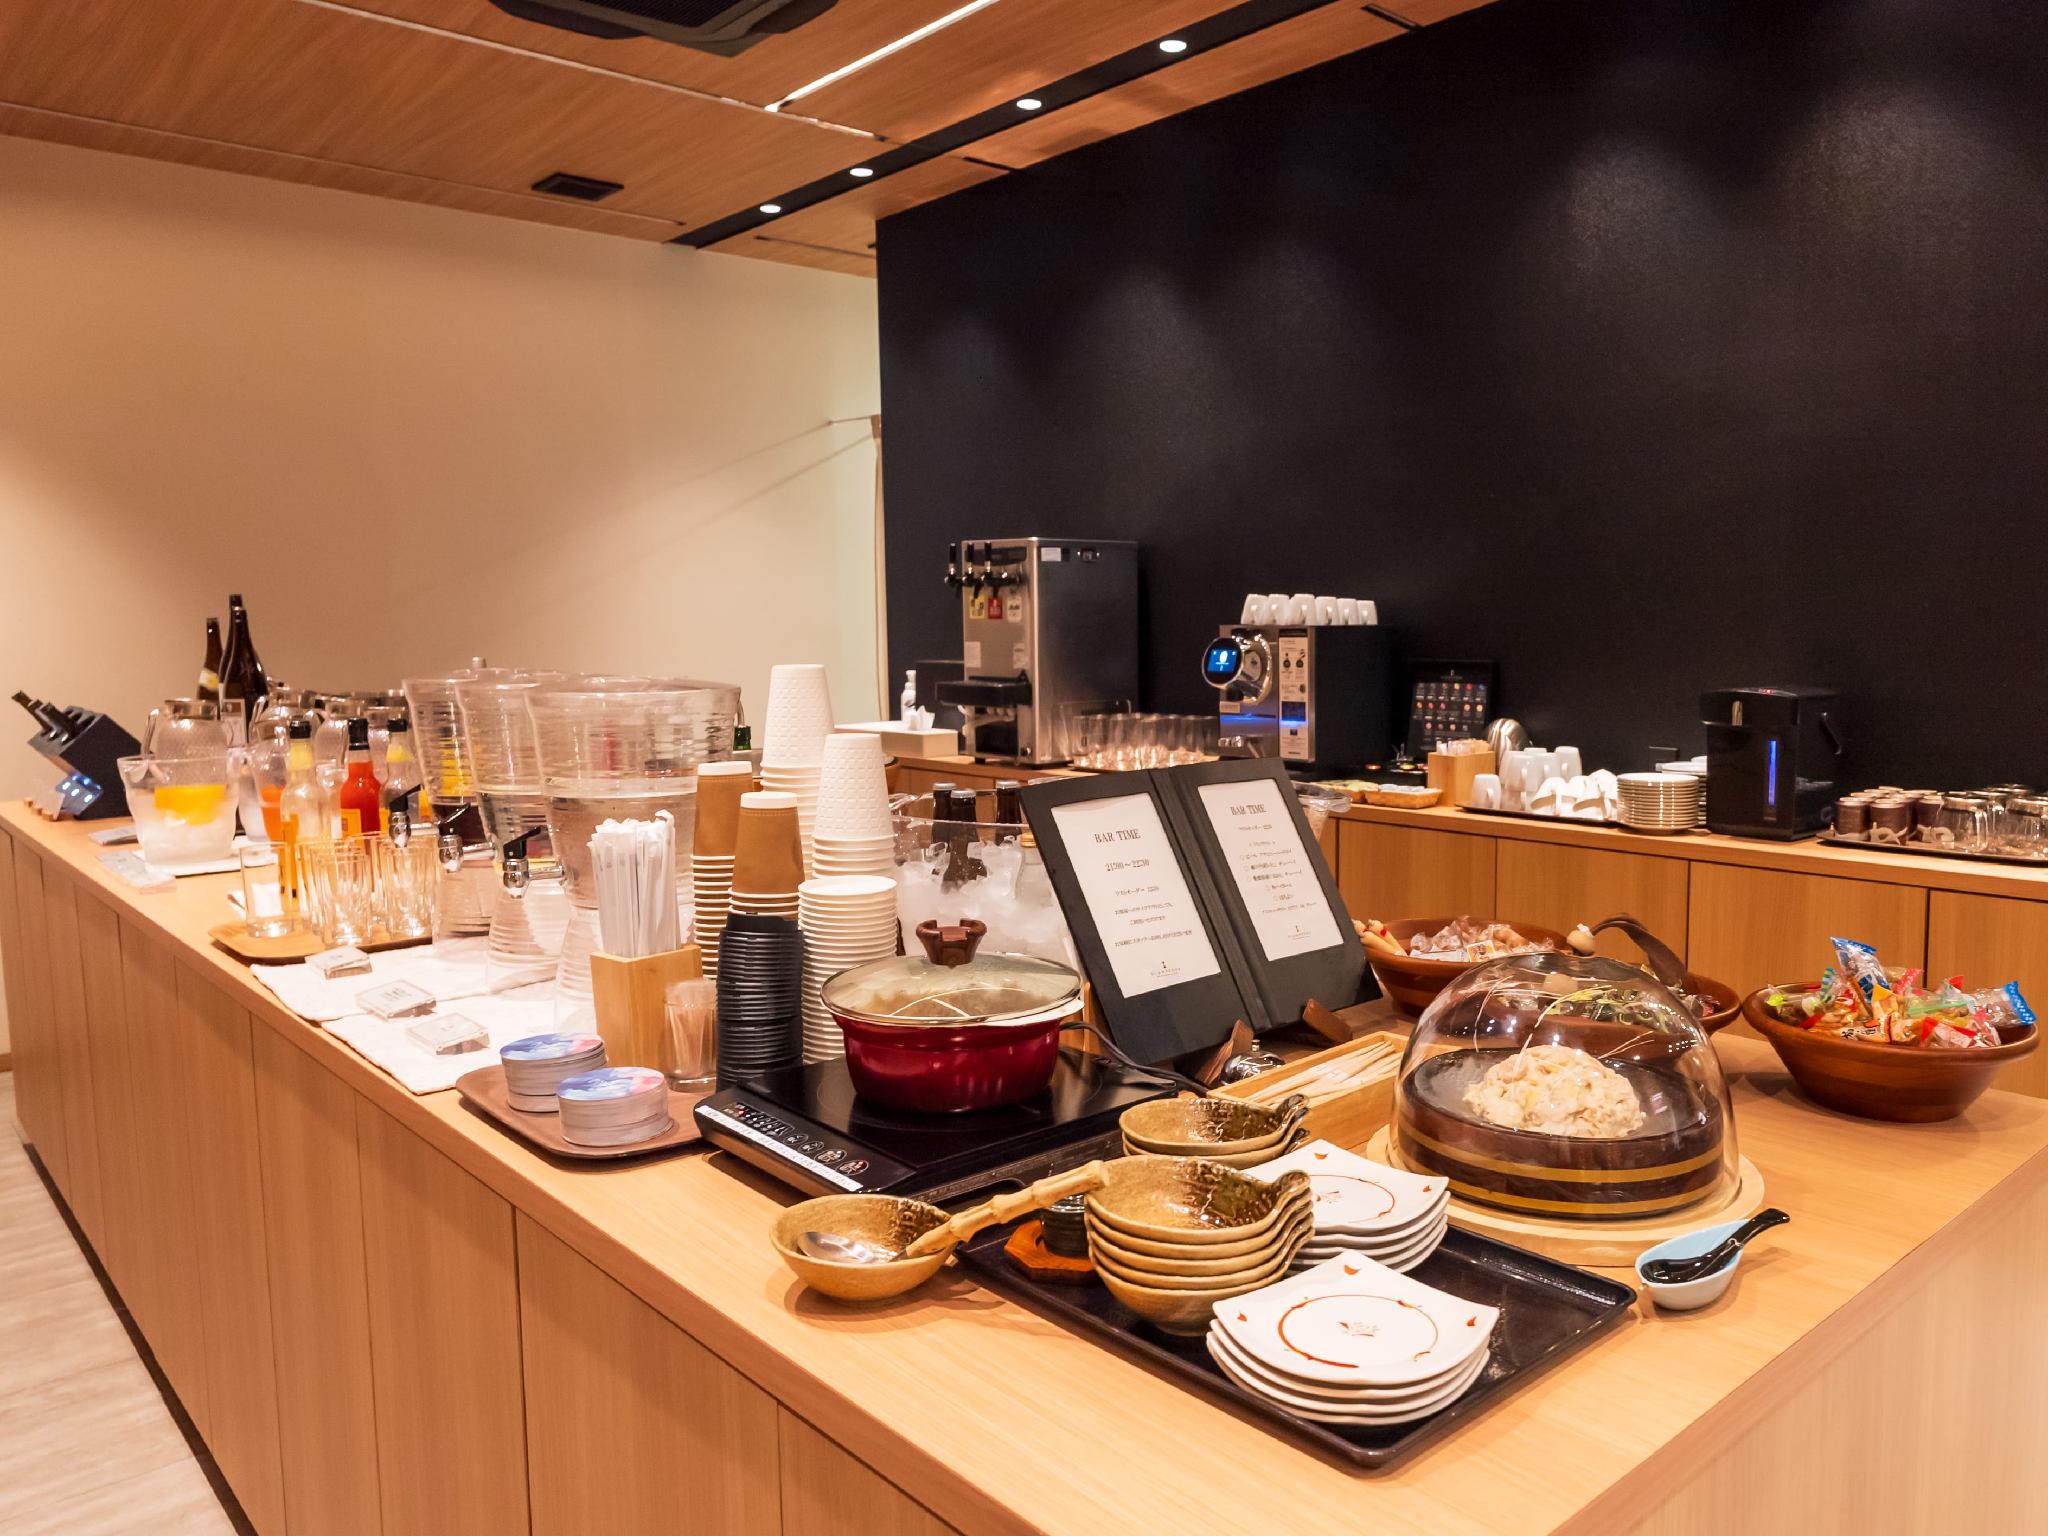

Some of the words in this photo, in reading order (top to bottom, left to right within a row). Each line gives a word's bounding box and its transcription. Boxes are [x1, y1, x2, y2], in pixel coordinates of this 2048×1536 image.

[1230, 805, 1246, 816] BAR
[1247, 803, 1267, 813] TIME
[1094, 830, 1115, 843] BAR
[1116, 828, 1141, 841] TIME
